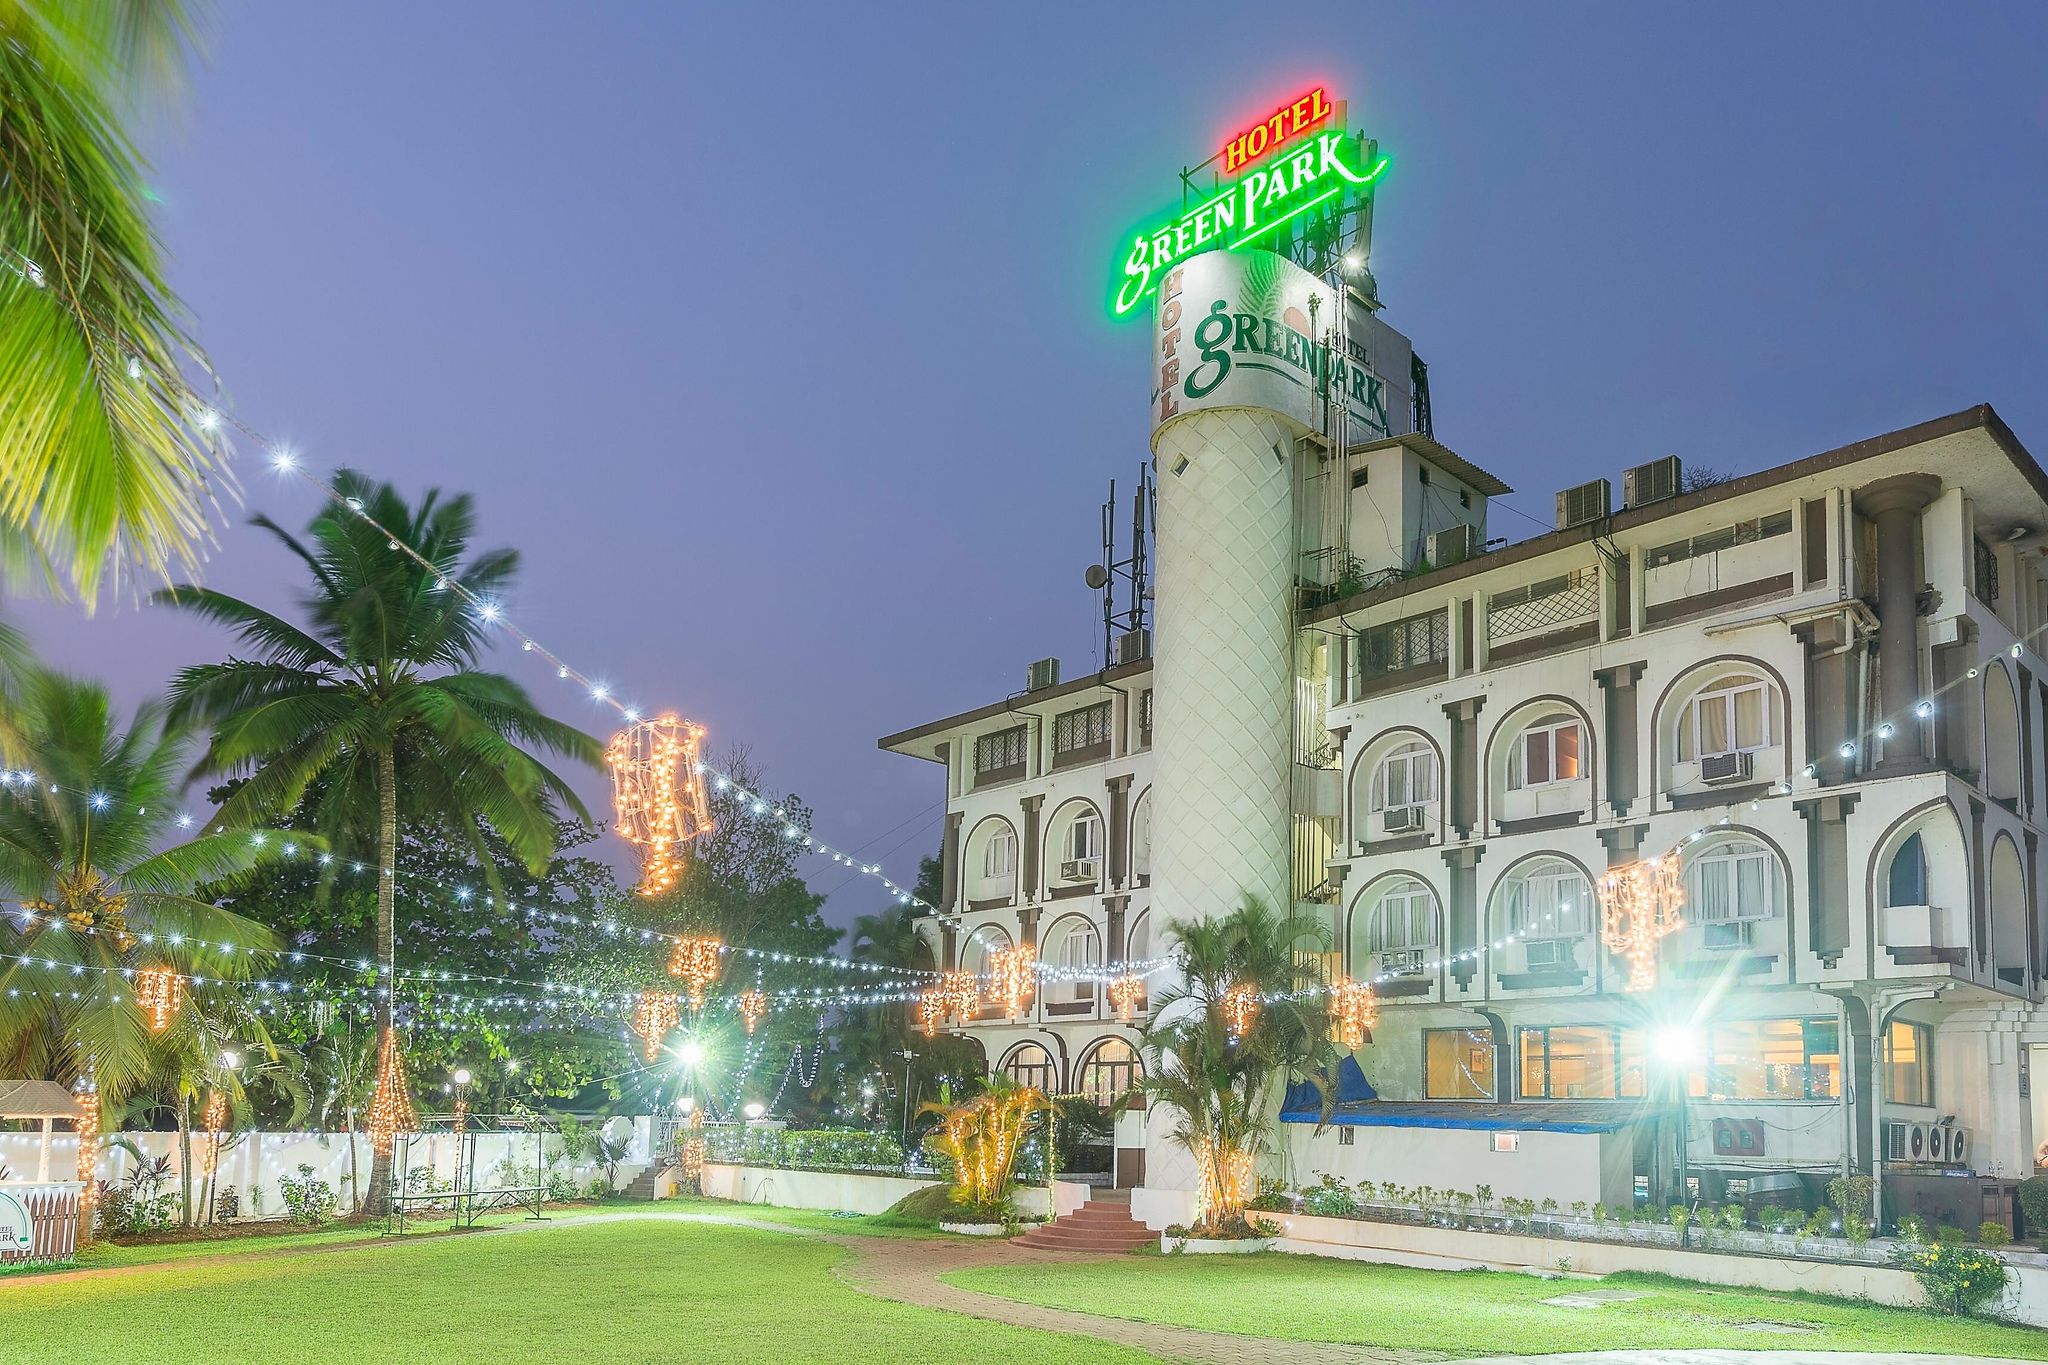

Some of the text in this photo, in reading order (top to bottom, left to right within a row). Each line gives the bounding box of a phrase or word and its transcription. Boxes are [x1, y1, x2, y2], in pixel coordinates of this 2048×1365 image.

[1226, 88, 1331, 173] HOTEL
[1242, 133, 1388, 232] PARK
[1160, 267, 1184, 422] HOTEL
[1315, 343, 1392, 437] PARK
